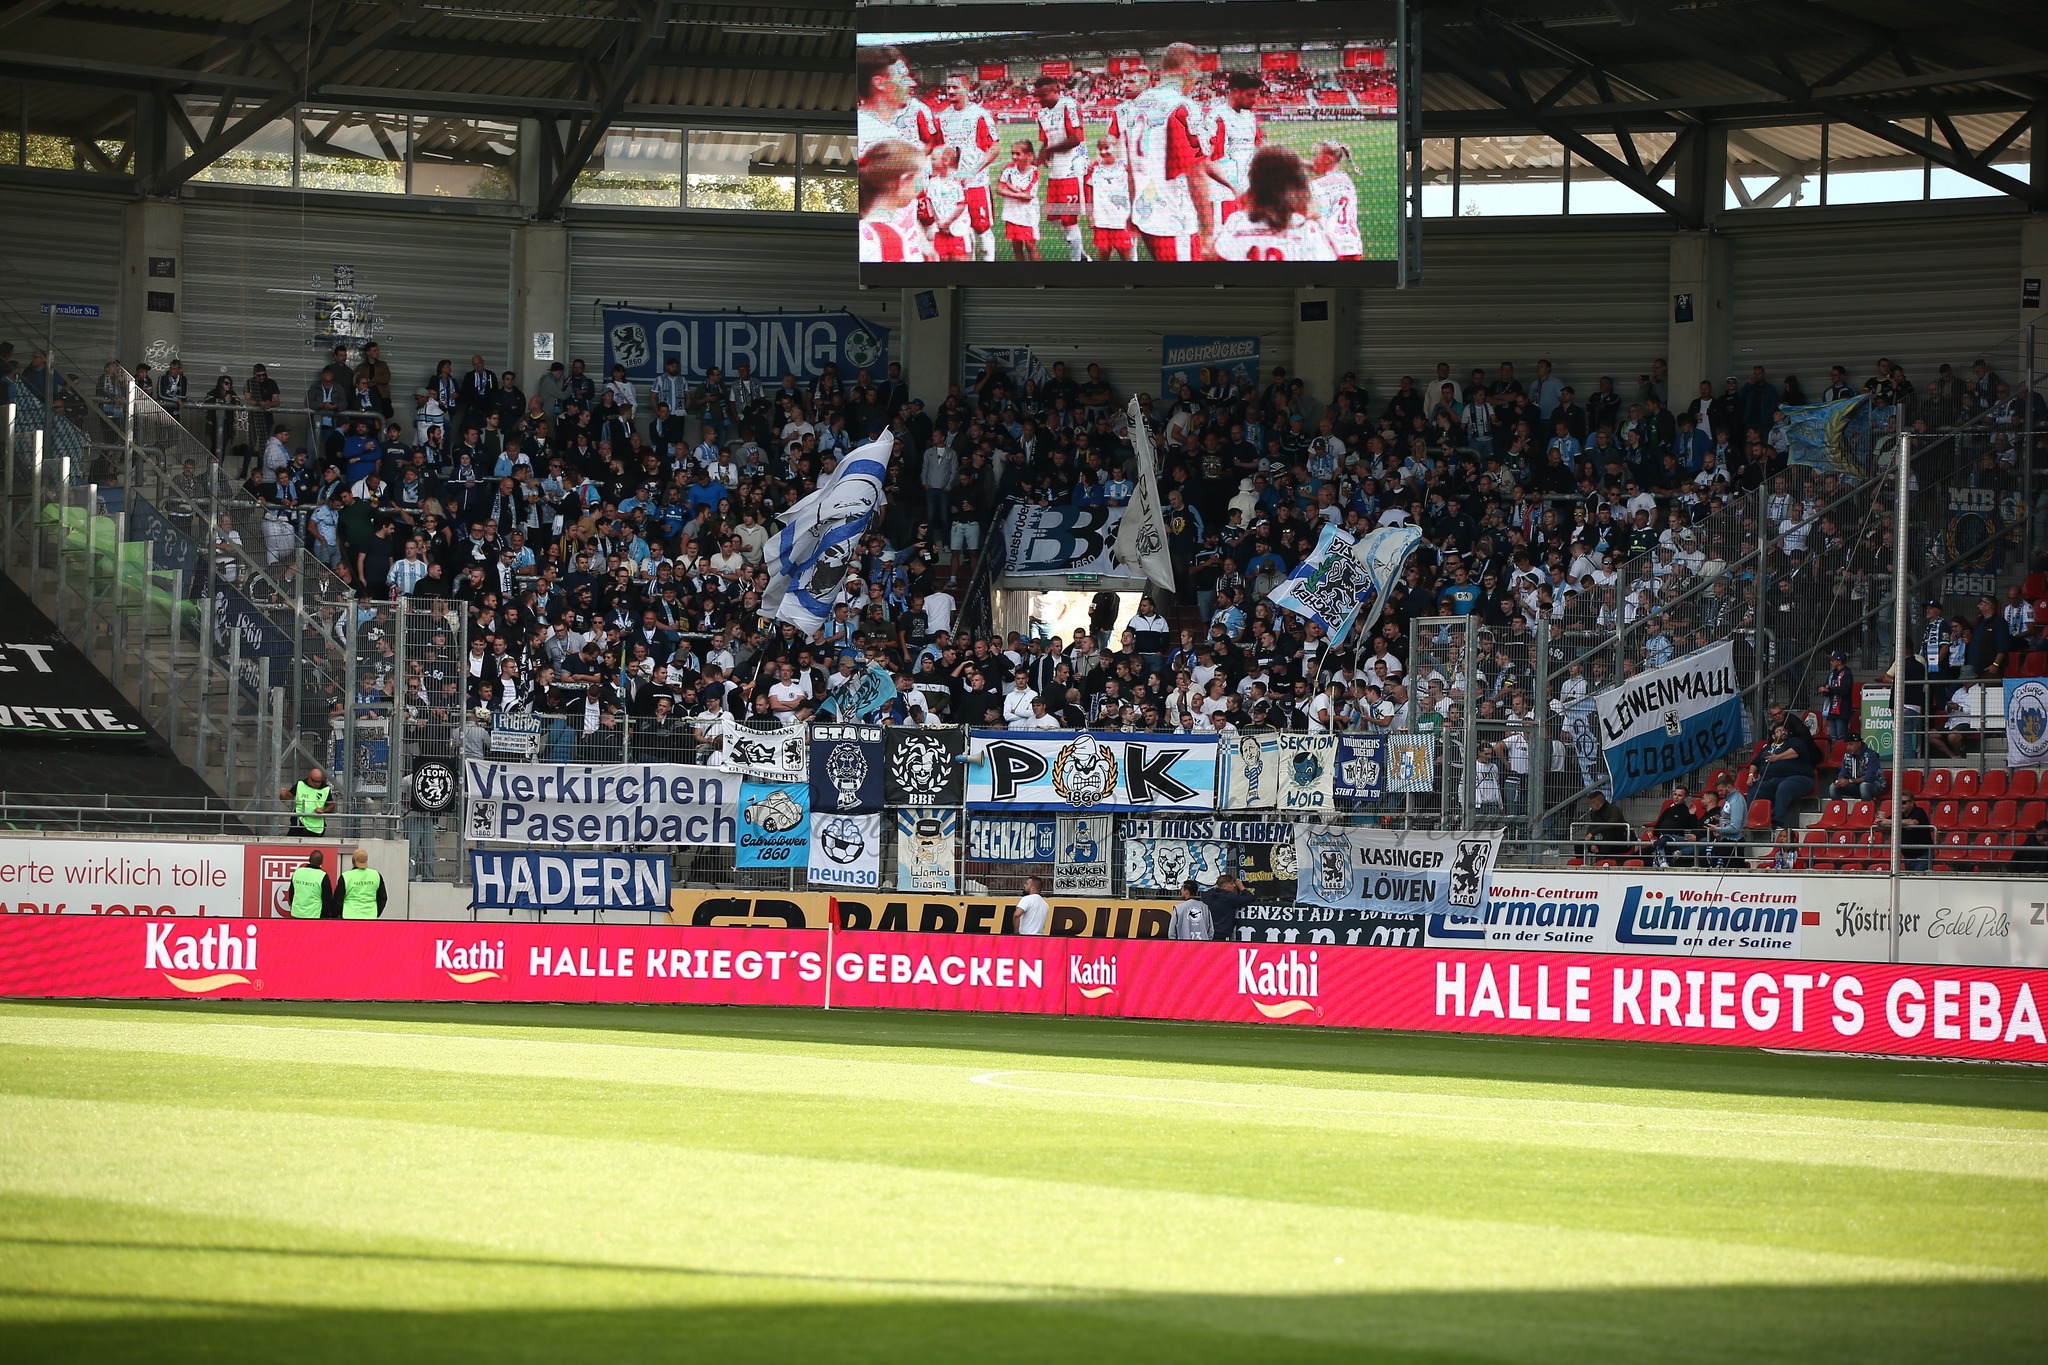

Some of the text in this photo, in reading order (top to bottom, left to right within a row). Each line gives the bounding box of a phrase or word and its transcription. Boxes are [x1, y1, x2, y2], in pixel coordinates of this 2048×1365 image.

[84, 307, 98, 316] Str.
[656, 320, 837, 377] AUBING
[1168, 340, 1254, 364] NACHRÜCKER
[625, 358, 642, 366] 1860
[1948, 487, 1995, 512] MTB
[1005, 504, 1031, 572] bluetsbrüder
[1070, 554, 1096, 568] 1860
[1603, 667, 1735, 740] LÖWENMAUL
[813, 726, 881, 741] CTA 90
[1280, 735, 1335, 751] SEKTION
[1342, 735, 1381, 749] MÜNCHENS
[1353, 747, 1375, 757] JUGEND
[1626, 719, 1728, 779] COBURG
[421, 768, 449, 777] LEONI
[763, 772, 799, 782] RECHTS
[986, 740, 1200, 805] P K
[470, 762, 724, 806] Vierkirchen
[1335, 787, 1355, 797] STEHT
[1370, 789, 1381, 798] TSV
[908, 793, 936, 805] BBF
[1066, 790, 1103, 803] 1860
[500, 802, 737, 843] Pasenbach
[1118, 819, 1293, 844] 50+1 MUSS BLEIBEN!
[740, 833, 809, 848] Cabriolöwen
[969, 820, 1036, 860] SECHZIG
[756, 848, 791, 860] 1860
[1360, 848, 1444, 868] KASINGER
[64, 857, 161, 886] wirklich
[172, 859, 227, 888] tolle
[474, 855, 666, 907] HADERN
[809, 867, 877, 885] neun30
[1056, 864, 1107, 876] KNACKEN
[1056, 876, 1109, 889] UNS NICHT
[1361, 873, 1437, 903] LÖWEN
[1489, 886, 1599, 900] Wohn-Centrum
[1679, 890, 1798, 904] Wohn-Centrum
[1615, 885, 1799, 945] Lührmann
[1927, 907, 1973, 939] Edel
[1968, 905, 2011, 939] Pils
[145, 922, 258, 971] Kathi
[1492, 931, 1594, 943] an der Saline
[1683, 936, 1793, 949] an der Saline
[435, 939, 505, 970] Kathi
[530, 946, 634, 977] HALLE
[835, 952, 1043, 989] GEBACKEN
[1069, 953, 1117, 985] Kathi
[1237, 947, 1319, 998] Kathi
[1436, 961, 1591, 1023] HALLE
[1886, 978, 2048, 1045] GEBA
